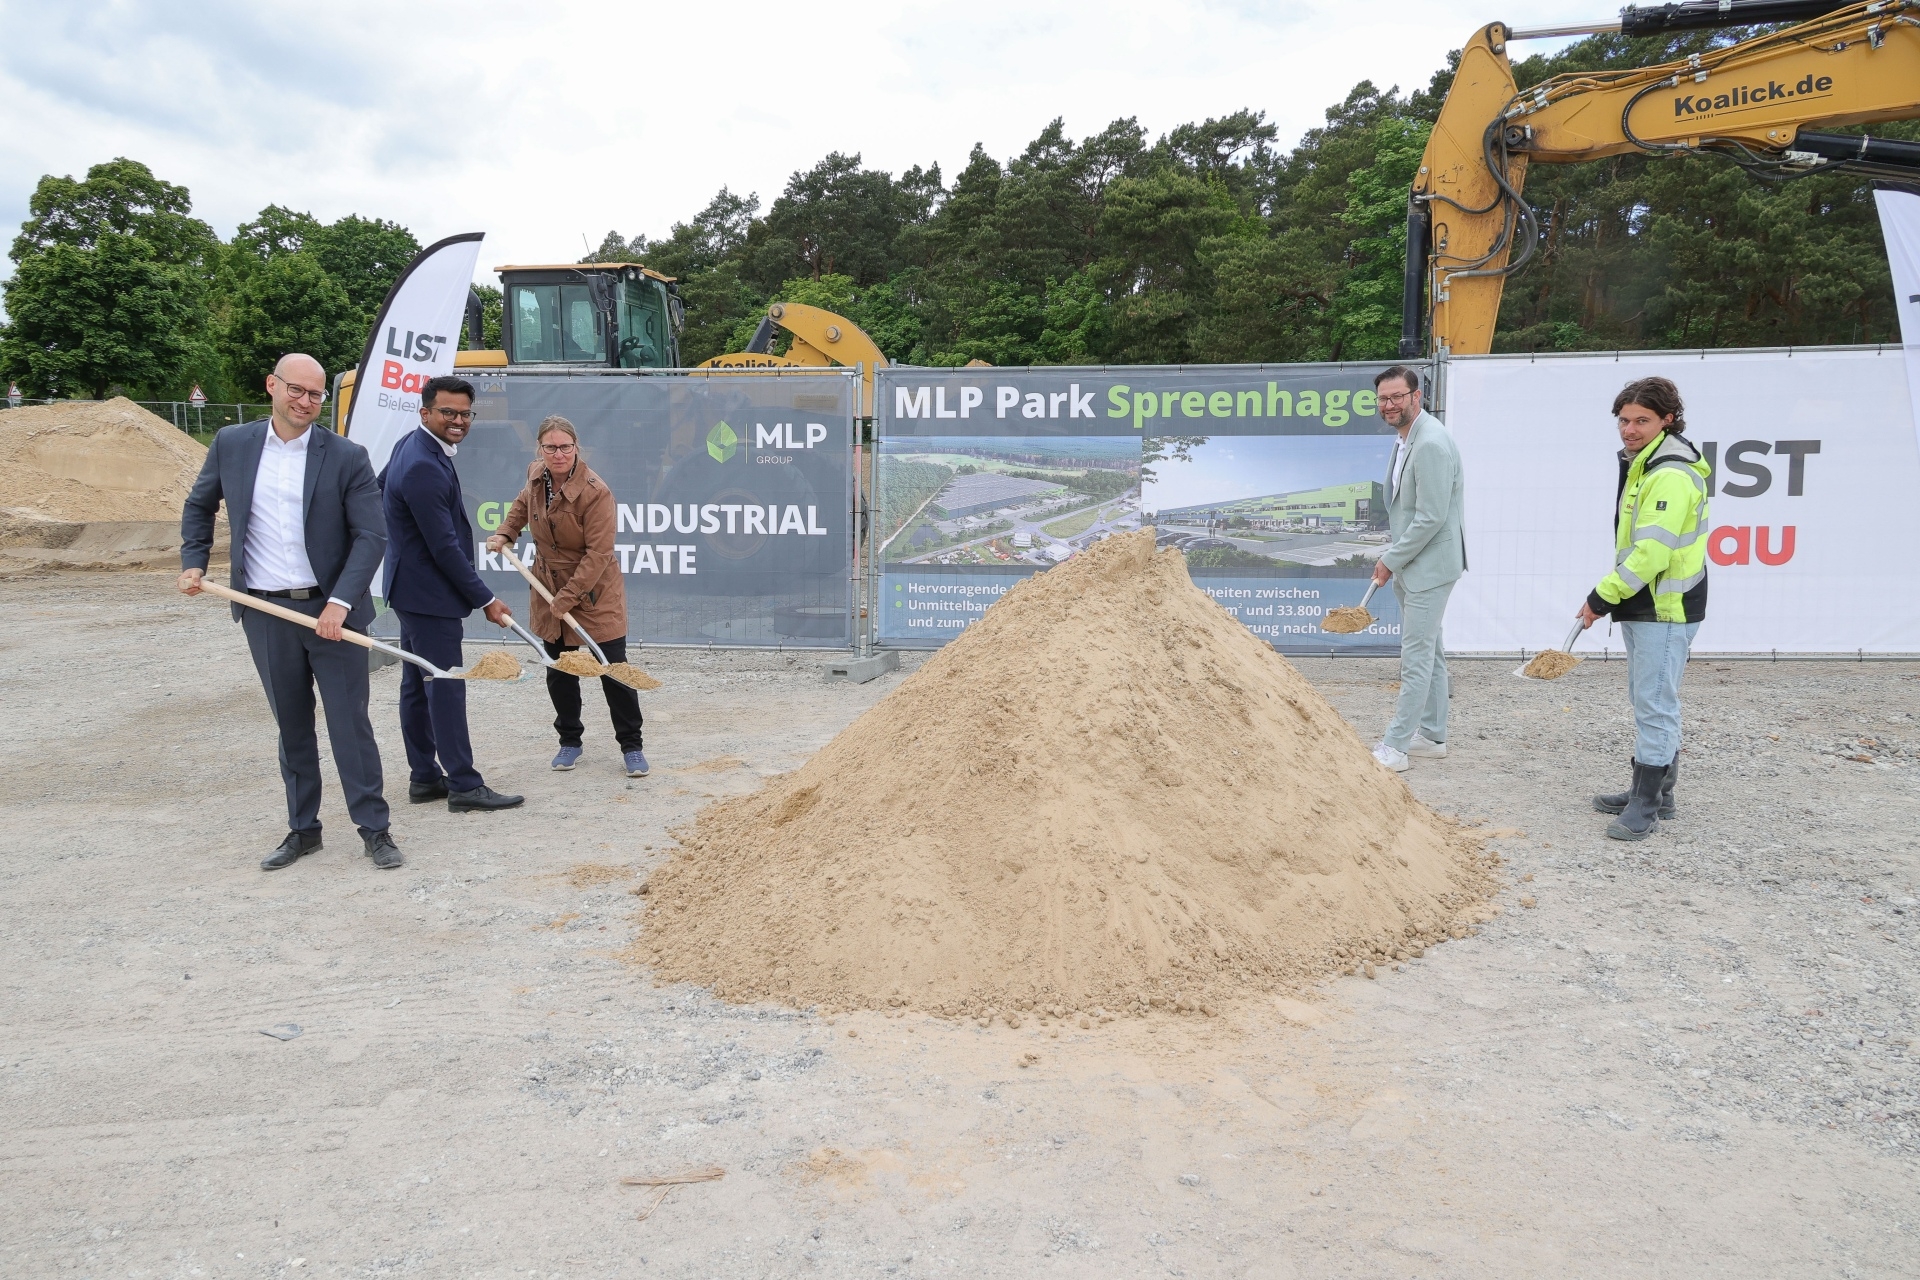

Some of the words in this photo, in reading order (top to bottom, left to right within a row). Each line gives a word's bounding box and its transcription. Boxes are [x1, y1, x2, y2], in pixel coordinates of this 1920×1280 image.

[1674, 74, 1833, 117] Koalick.de
[386, 326, 447, 363] LIST
[895, 386, 983, 419] MLP
[996, 384, 1096, 419] Park
[1107, 381, 1376, 429] Spreenhage
[756, 423, 827, 448] MLP
[756, 455, 793, 464] GROUP
[1702, 439, 1821, 498] IST
[617, 503, 827, 535] NDUSTRIAL
[478, 541, 536, 571] REA
[614, 544, 697, 575] TATE
[1706, 525, 1796, 567] au
[908, 582, 1007, 597] Hervorragende
[1203, 587, 1251, 598] heiten
[1255, 587, 1320, 598] zwischen
[908, 617, 933, 628] und
[937, 619, 965, 628] zum
[1246, 605, 1273, 616] und
[1277, 605, 1321, 616] 33.800
[1247, 624, 1279, 637] rung
[1283, 623, 1317, 634] nach
